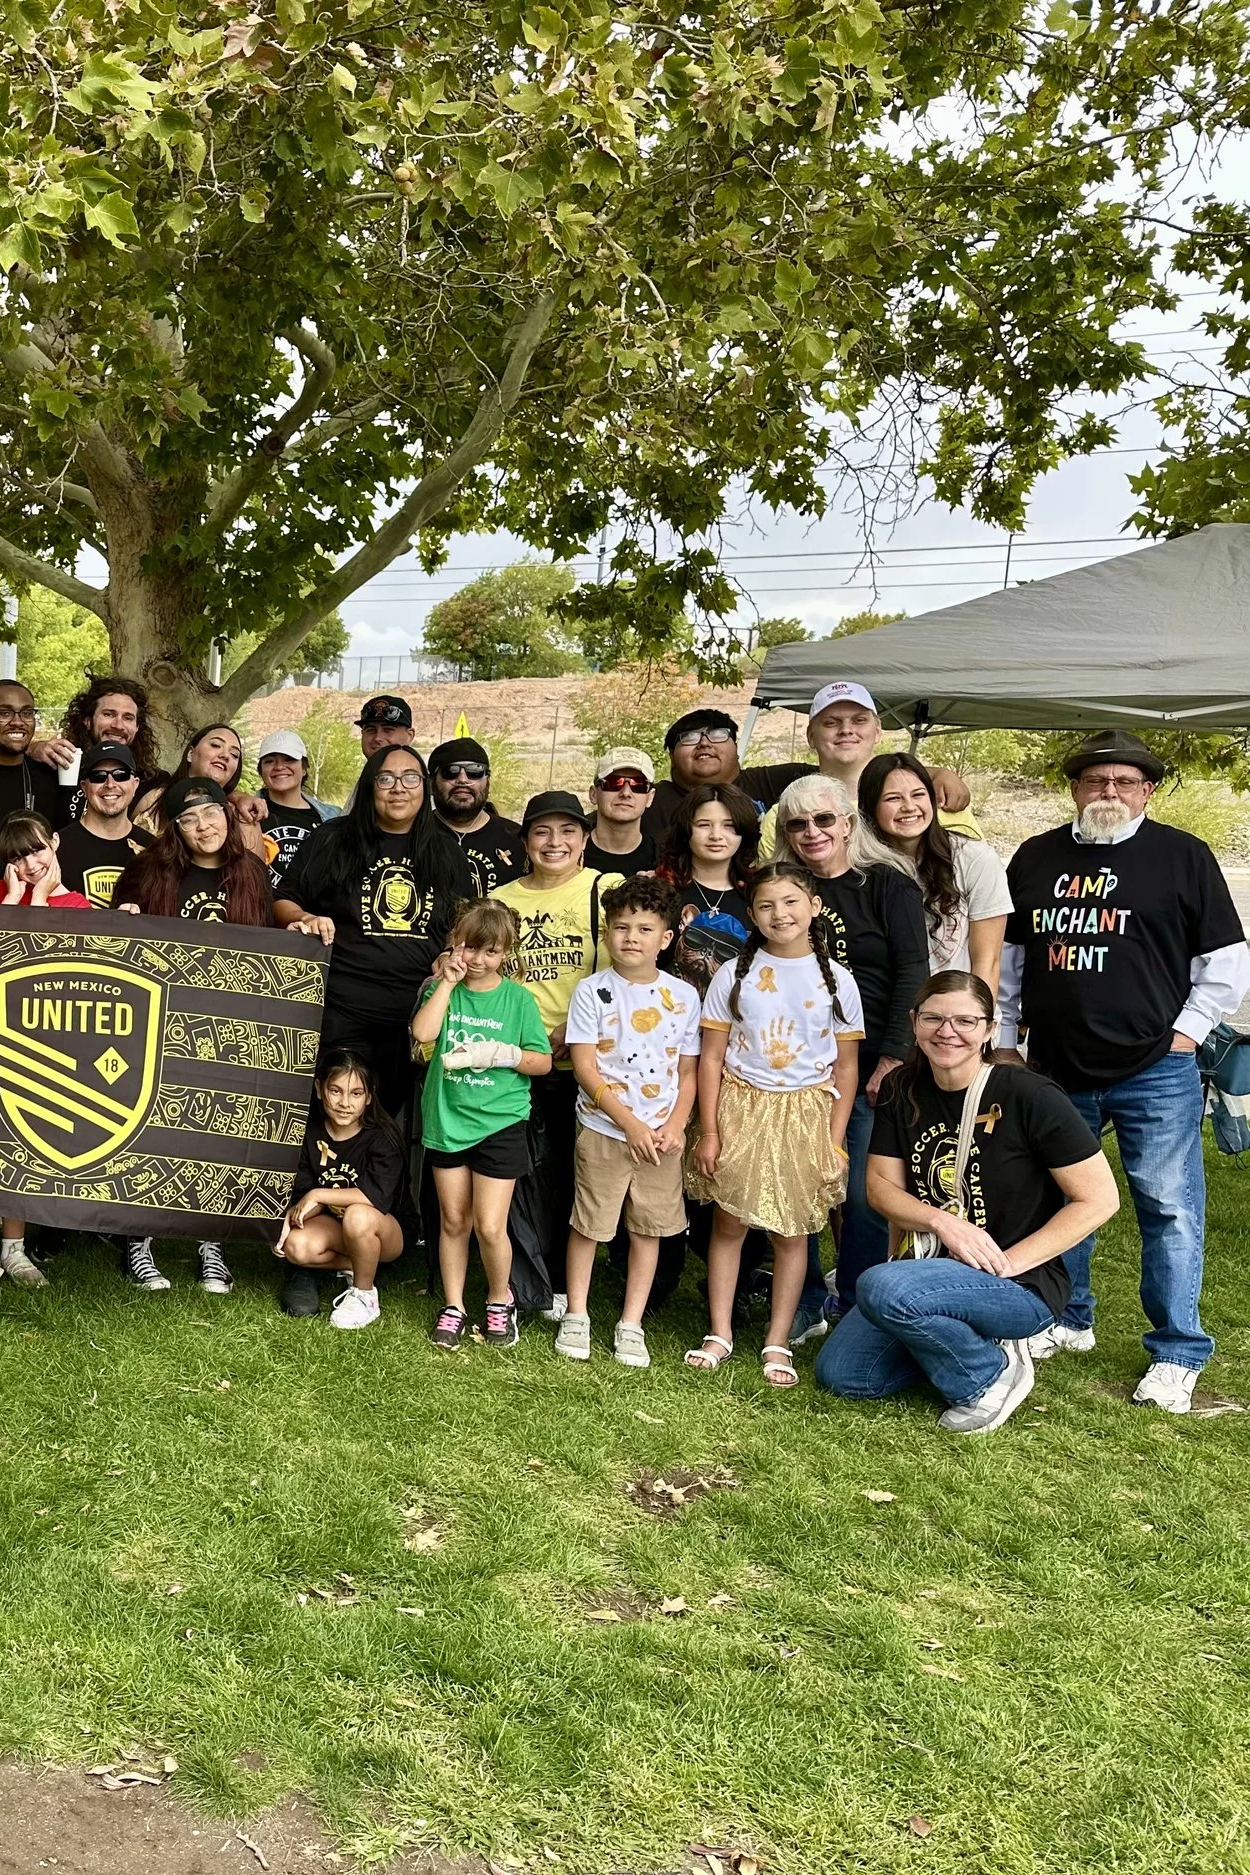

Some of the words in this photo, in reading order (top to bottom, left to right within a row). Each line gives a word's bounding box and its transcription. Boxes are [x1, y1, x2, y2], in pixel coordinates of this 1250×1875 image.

[467, 849, 495, 870] HATE
[1054, 867, 1118, 899] CAMP
[361, 896, 372, 930] LOVE
[821, 906, 846, 934] HATE
[1032, 907, 1131, 935] ENCHANT
[1048, 944, 1109, 973] MENT
[33, 981, 65, 992] NEW
[69, 980, 122, 996] MEXICO
[525, 967, 558, 983] 2025
[21, 997, 133, 1036] UNITED
[104, 1058, 118, 1073] 18
[915, 1179, 931, 1206] OVE
